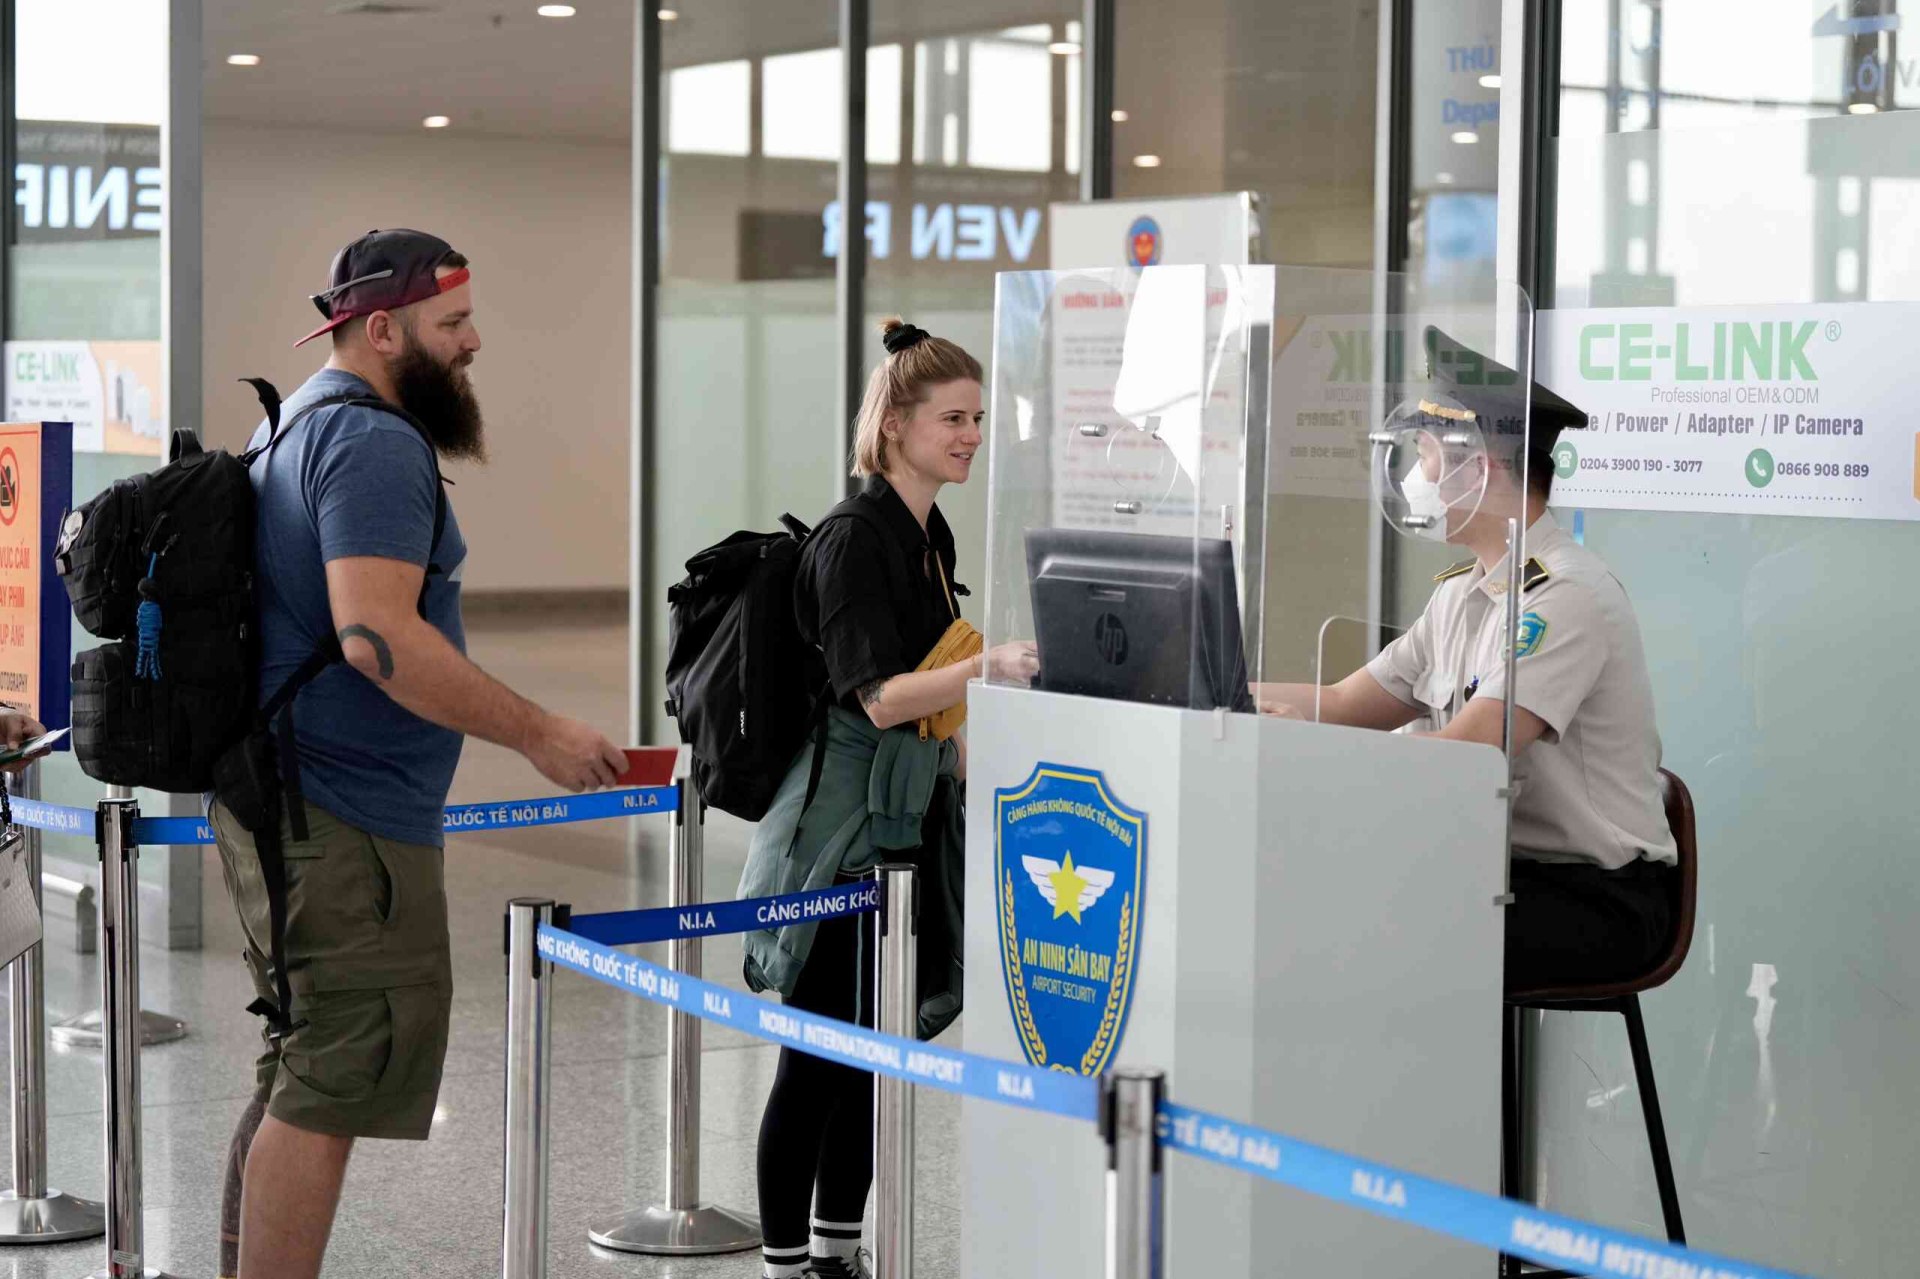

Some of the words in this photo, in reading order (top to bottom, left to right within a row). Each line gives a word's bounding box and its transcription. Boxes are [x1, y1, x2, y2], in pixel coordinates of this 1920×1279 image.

[1579, 320, 1819, 382] CE-LINK
[15, 351, 81, 382] CE-LINK
[1651, 386, 1732, 405] Professional
[1735, 386, 1819, 405] OEM&ODM
[1616, 412, 1669, 434] Power
[1687, 412, 1755, 438] Adapter
[1773, 414, 1790, 435] IP
[1795, 413, 1864, 436] Camera
[1580, 458, 1609, 471] 0204
[1611, 458, 1641, 472] 3900
[1643, 459, 1663, 473] 190
[1673, 459, 1703, 474] 3077
[1777, 462, 1811, 477] 0866
[1814, 462, 1840, 477] 908
[1844, 463, 1870, 479] 889
[489, 804, 508, 824] TẾ
[512, 805, 539, 825] NỘI
[543, 801, 569, 820] BÀI
[623, 794, 659, 809] N.I.A
[1047, 797, 1075, 815] KHÔNG
[678, 911, 716, 931] N.I.A
[756, 899, 800, 925] CẢNG
[803, 894, 846, 918] HÀNG
[1022, 937, 1038, 966] AN
[1040, 940, 1066, 974] NINH
[1067, 943, 1089, 979] SÂN
[1090, 951, 1112, 983] BAY
[1031, 974, 1062, 997] AIRPORT
[1062, 980, 1097, 1004] SECURITY
[555, 938, 590, 969] KHÔNG
[592, 952, 622, 982] QUỐC
[623, 961, 638, 987] TẾ
[638, 968, 659, 996] NỘI
[905, 1050, 965, 1085] AIRPORT
